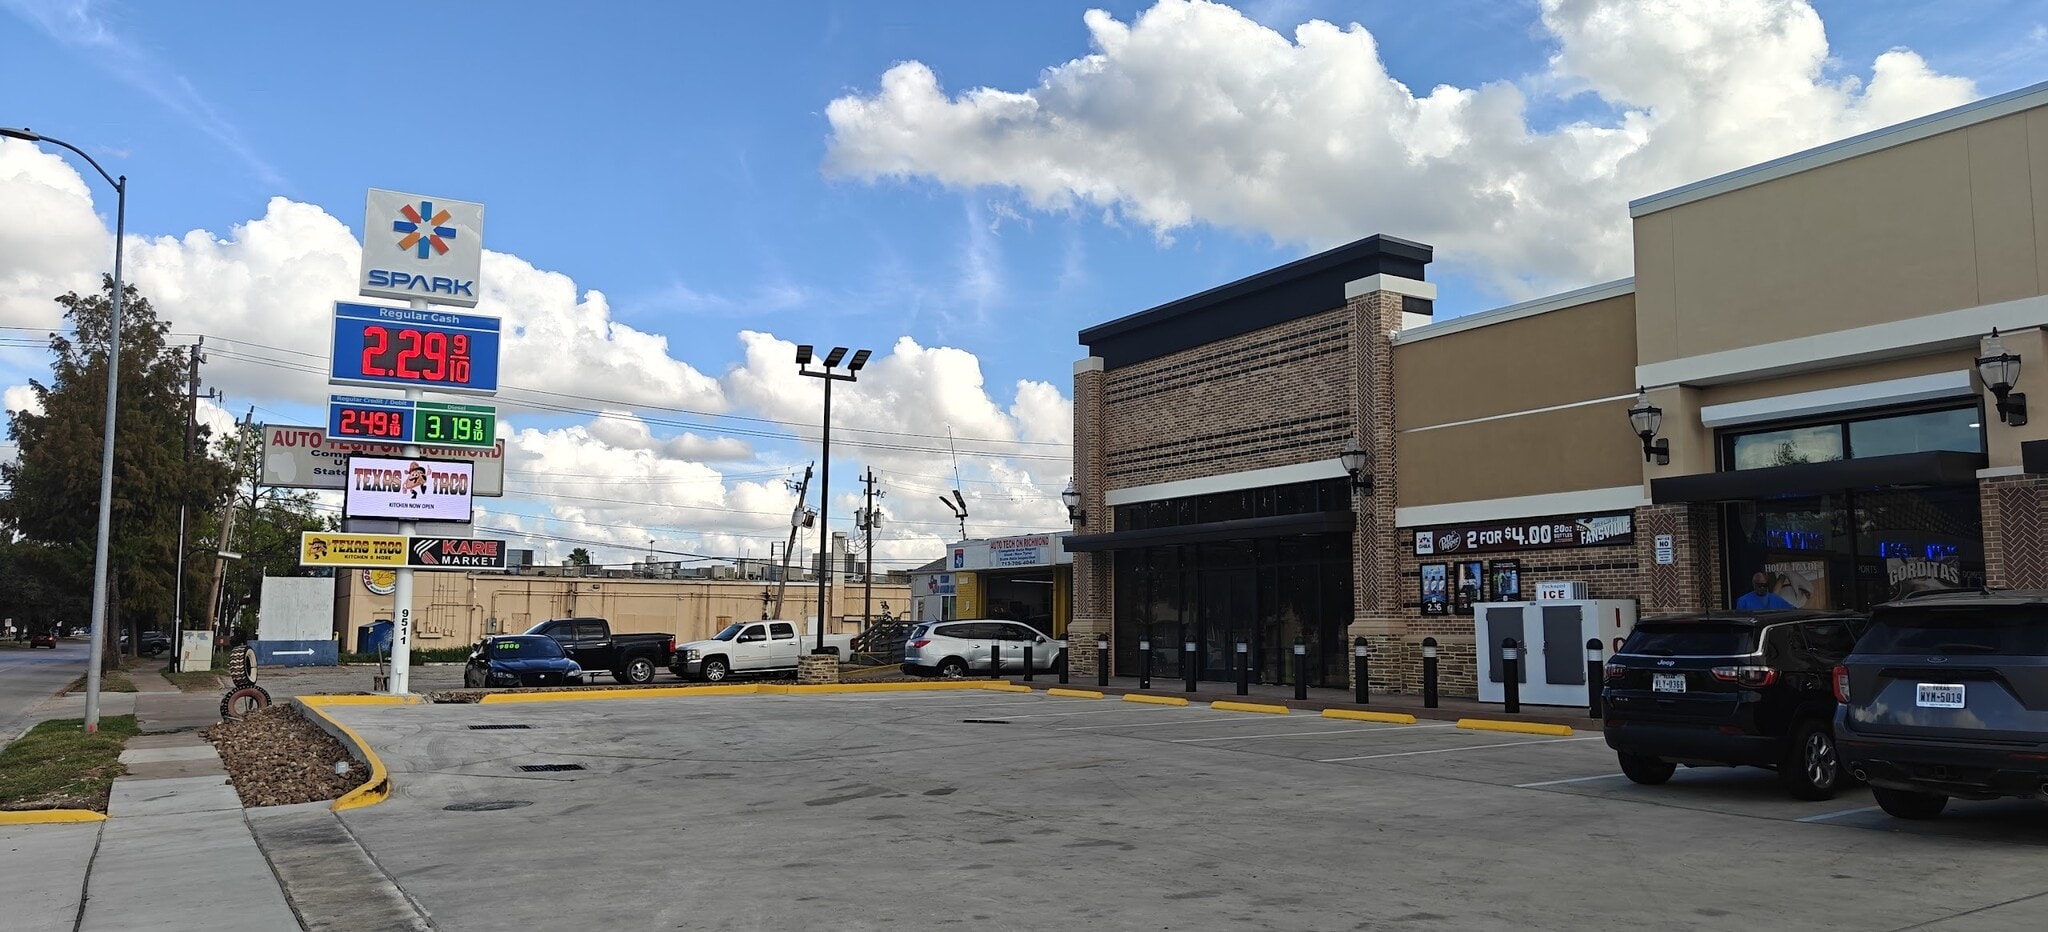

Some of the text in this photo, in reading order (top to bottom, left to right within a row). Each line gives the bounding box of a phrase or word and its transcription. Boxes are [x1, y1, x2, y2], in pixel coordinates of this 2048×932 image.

[368, 269, 473, 296] SPARK
[379, 308, 460, 324] Regular Cash
[362, 326, 446, 381] 2.29
[336, 395, 362, 403] Regular
[363, 396, 383, 404] Credit
[341, 409, 388, 436] 2.49
[427, 415, 471, 440] 3.19
[271, 430, 322, 448] AUTO
[311, 450, 348, 459] Comp
[354, 467, 468, 495] TEXAS TACO
[1466, 530, 1478, 549] 2
[1480, 530, 1503, 545] FOR
[1504, 525, 1551, 545] $4.00
[331, 539, 402, 555] TEXAS TACO
[442, 540, 498, 556] KARE
[441, 556, 497, 566] MARKET
[1889, 561, 1959, 586] GORDITAS
[1543, 590, 1566, 599] ICE
[400, 609, 409, 645] 9511
[1657, 659, 1675, 667] Jeep
